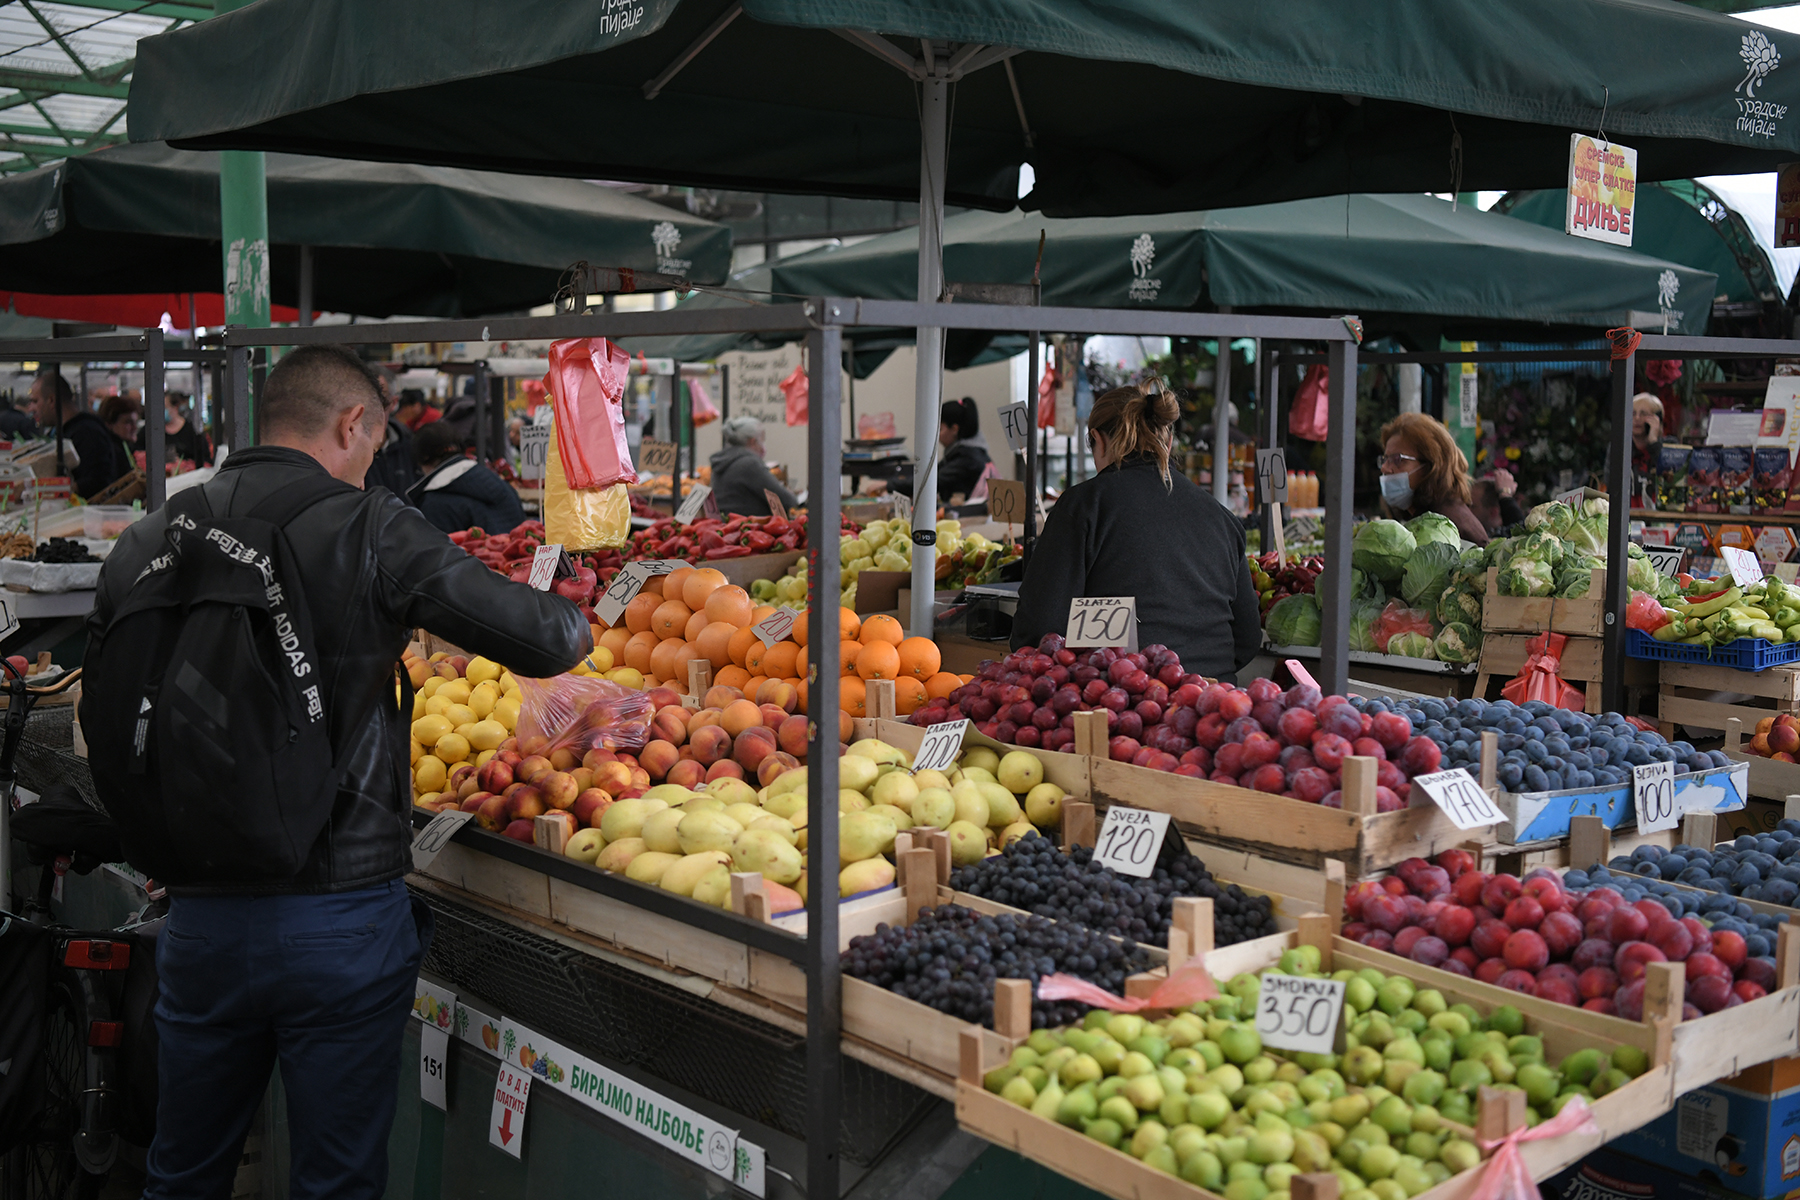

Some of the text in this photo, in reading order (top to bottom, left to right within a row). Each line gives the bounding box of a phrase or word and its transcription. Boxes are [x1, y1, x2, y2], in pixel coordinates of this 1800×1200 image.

[600, 6, 644, 37] пијаце
[1735, 98, 1788, 119] Градске
[1736, 117, 1776, 139] пијаце
[1586, 146, 1625, 168] СРЕМСКЕ
[1574, 165, 1635, 193] СУПЕР СЛАТКЕ
[1573, 196, 1631, 235] ДИЊЕ
[1000, 406, 1028, 438] 70
[1260, 453, 1286, 490] 40
[993, 487, 1014, 517] 60
[530, 558, 557, 588] 250
[607, 570, 642, 606] 250
[759, 611, 794, 643] 200
[1072, 607, 1131, 641] 150
[273, 613, 312, 678] ADIDAS
[910, 733, 960, 774] 200
[1442, 780, 1495, 824] 170
[1639, 778, 1672, 824] 100
[1103, 825, 1155, 865] 120
[1260, 996, 1332, 1036] 350
[423, 1055, 443, 1080] 151
[495, 1088, 526, 1115] ПЛАТИТЕ
[571, 1065, 705, 1154] БИРАЈМО НАЈБОЉЕ
